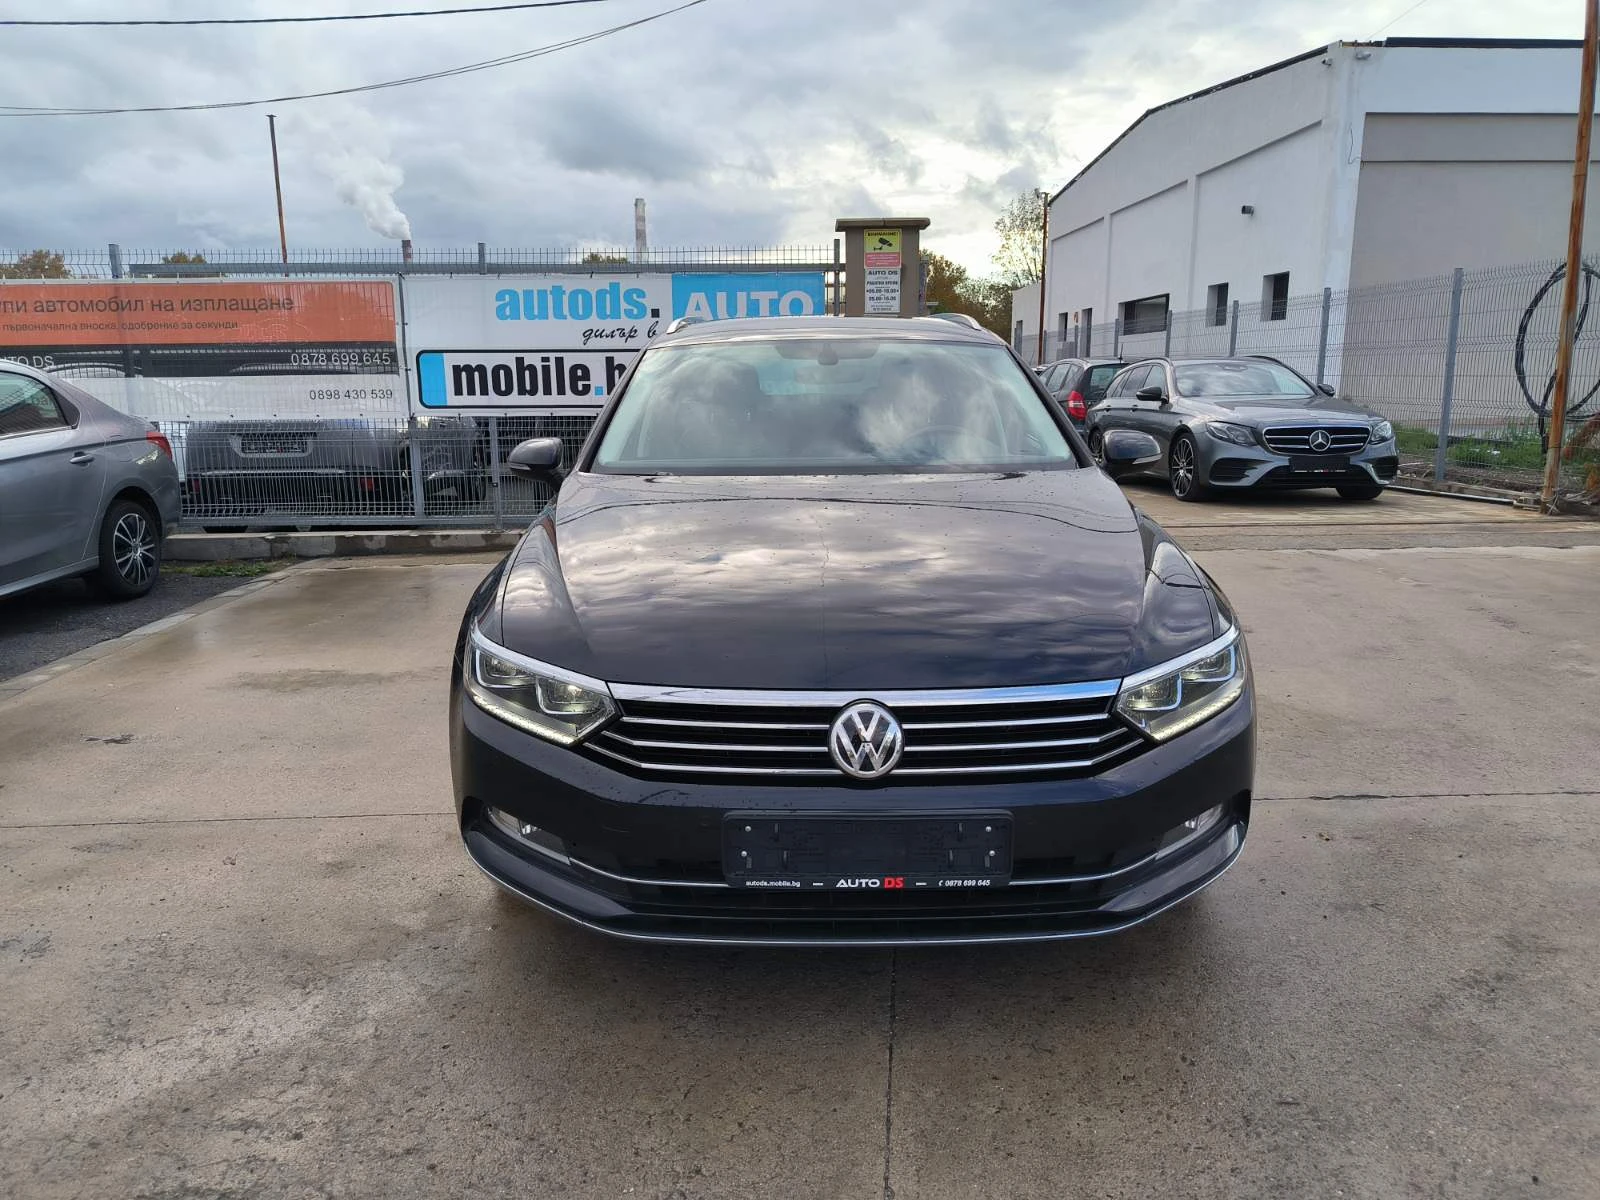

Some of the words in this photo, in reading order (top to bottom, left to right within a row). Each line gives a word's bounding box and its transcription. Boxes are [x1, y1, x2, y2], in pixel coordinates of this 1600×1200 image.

[0, 300, 27, 313] пи
[33, 296, 145, 313] автомобил
[152, 299, 175, 313] на
[180, 298, 294, 313] изплащане
[495, 282, 660, 321] autods.
[685, 291, 814, 321] AUTO
[121, 320, 179, 331] одобрение
[182, 321, 193, 330] за
[195, 320, 238, 330] секунди
[582, 324, 639, 346] дилър
[291, 353, 327, 366] 0878
[331, 352, 359, 365] 699
[363, 352, 391, 365] 645
[309, 389, 340, 400] 0898
[344, 389, 367, 400] 430
[370, 388, 393, 400] 539
[835, 878, 880, 888] AUTO
[883, 877, 904, 889] DS
[944, 879, 962, 888] 0878
[963, 879, 976, 887] 699
[977, 879, 991, 887] 645
